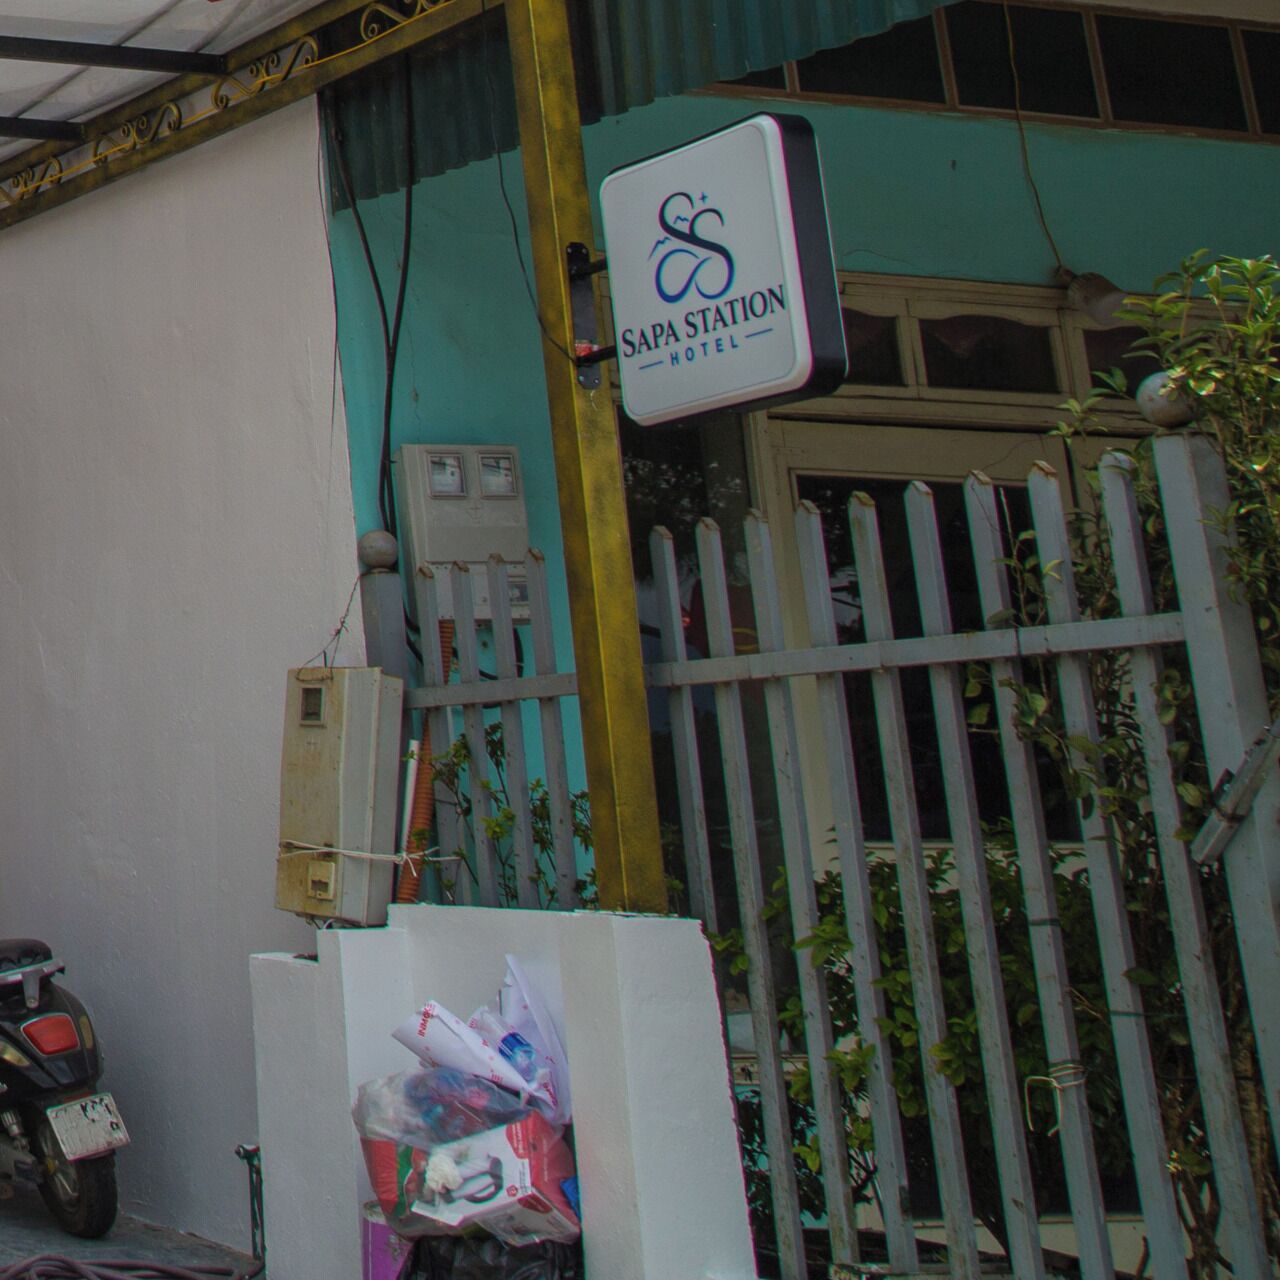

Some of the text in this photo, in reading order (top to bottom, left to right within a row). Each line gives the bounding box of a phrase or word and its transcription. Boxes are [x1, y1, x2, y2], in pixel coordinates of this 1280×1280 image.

[622, 283, 788, 359] SAPA STATION
[669, 337, 740, 368] HOTEL
